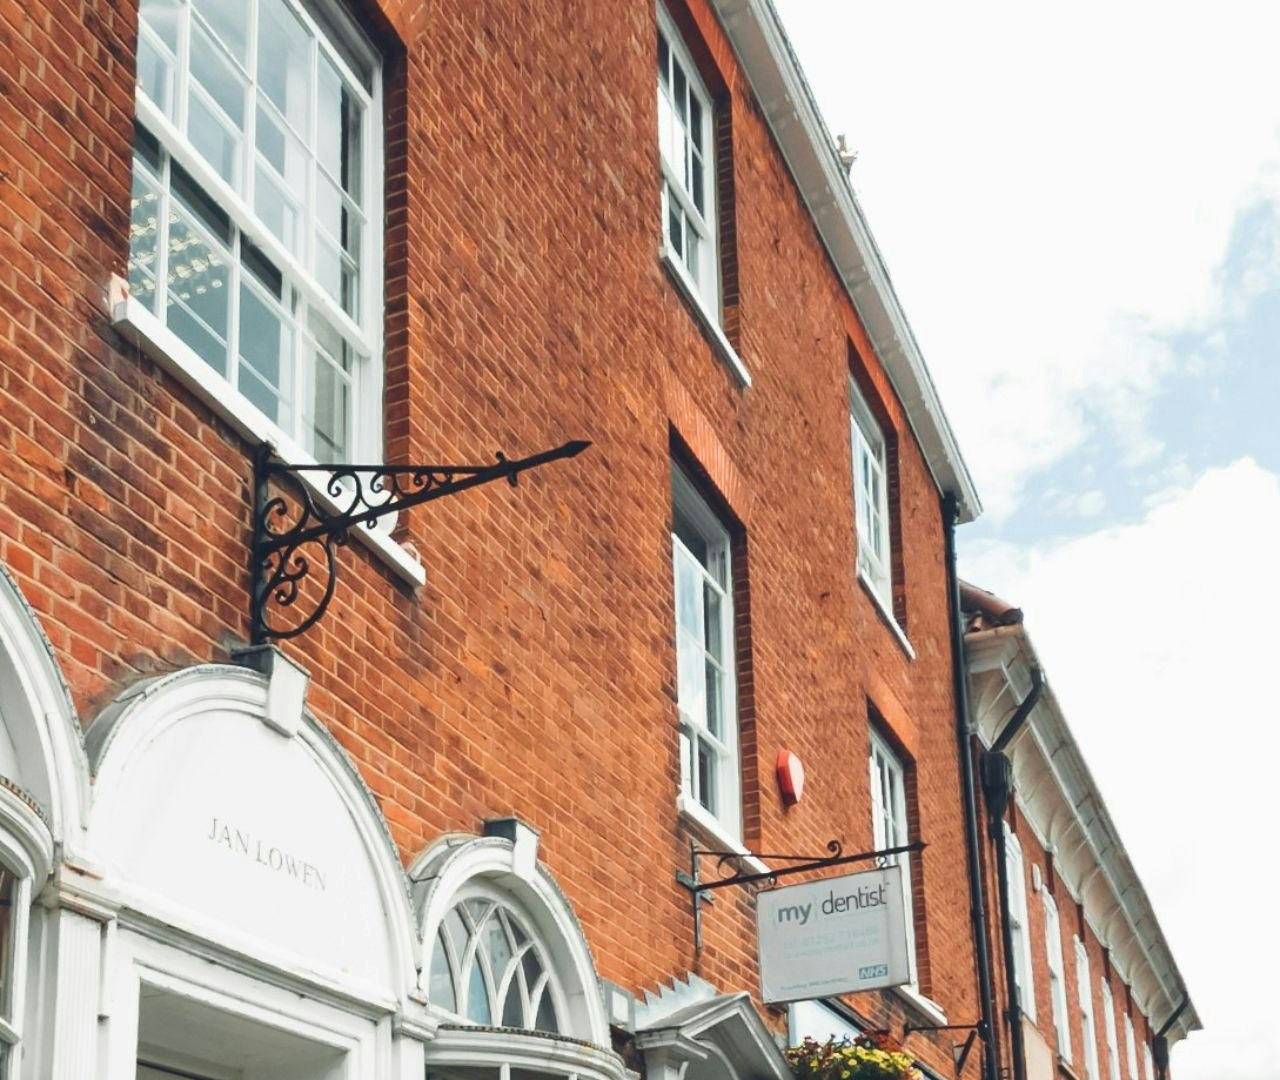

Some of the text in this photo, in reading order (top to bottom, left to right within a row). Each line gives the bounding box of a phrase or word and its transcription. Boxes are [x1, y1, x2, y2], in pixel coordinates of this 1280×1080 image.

[208, 818, 250, 855] JAN
[777, 884, 887, 925] my dentist
[860, 964, 887, 979] NHS
